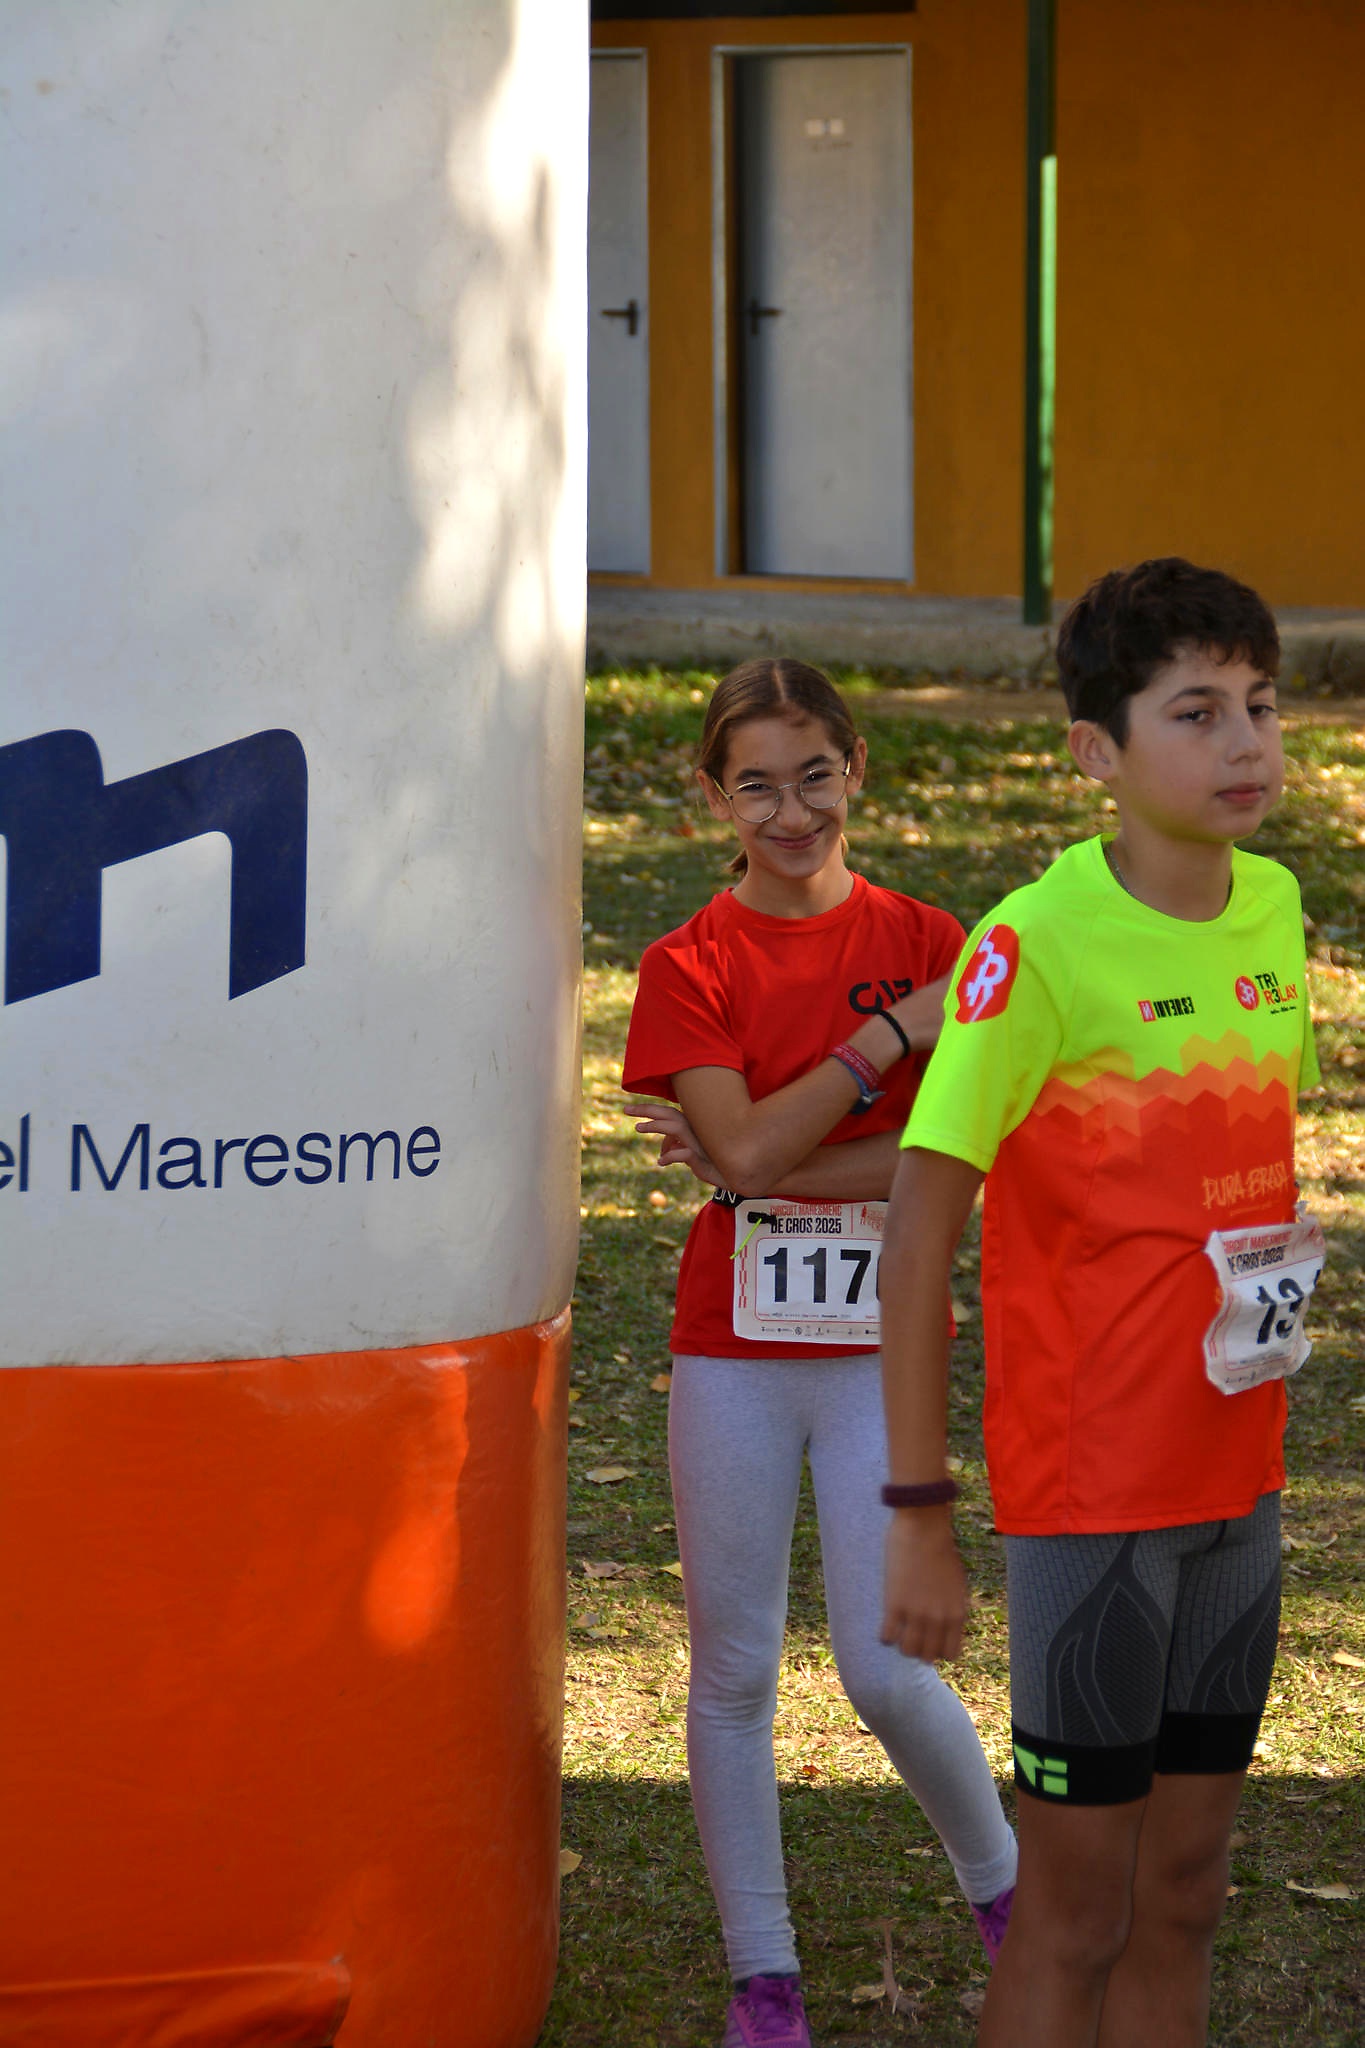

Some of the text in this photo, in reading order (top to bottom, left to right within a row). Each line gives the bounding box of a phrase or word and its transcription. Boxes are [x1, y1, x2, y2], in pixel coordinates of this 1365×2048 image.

[1254, 971, 1279, 990] TRI
[1263, 983, 1299, 1006] R3LAY
[70, 1122, 442, 1192] Maresme
[771, 1217, 842, 1235] DE CROS 2025
[763, 1247, 883, 1305] 117
[1256, 1269, 1321, 1345] 13
